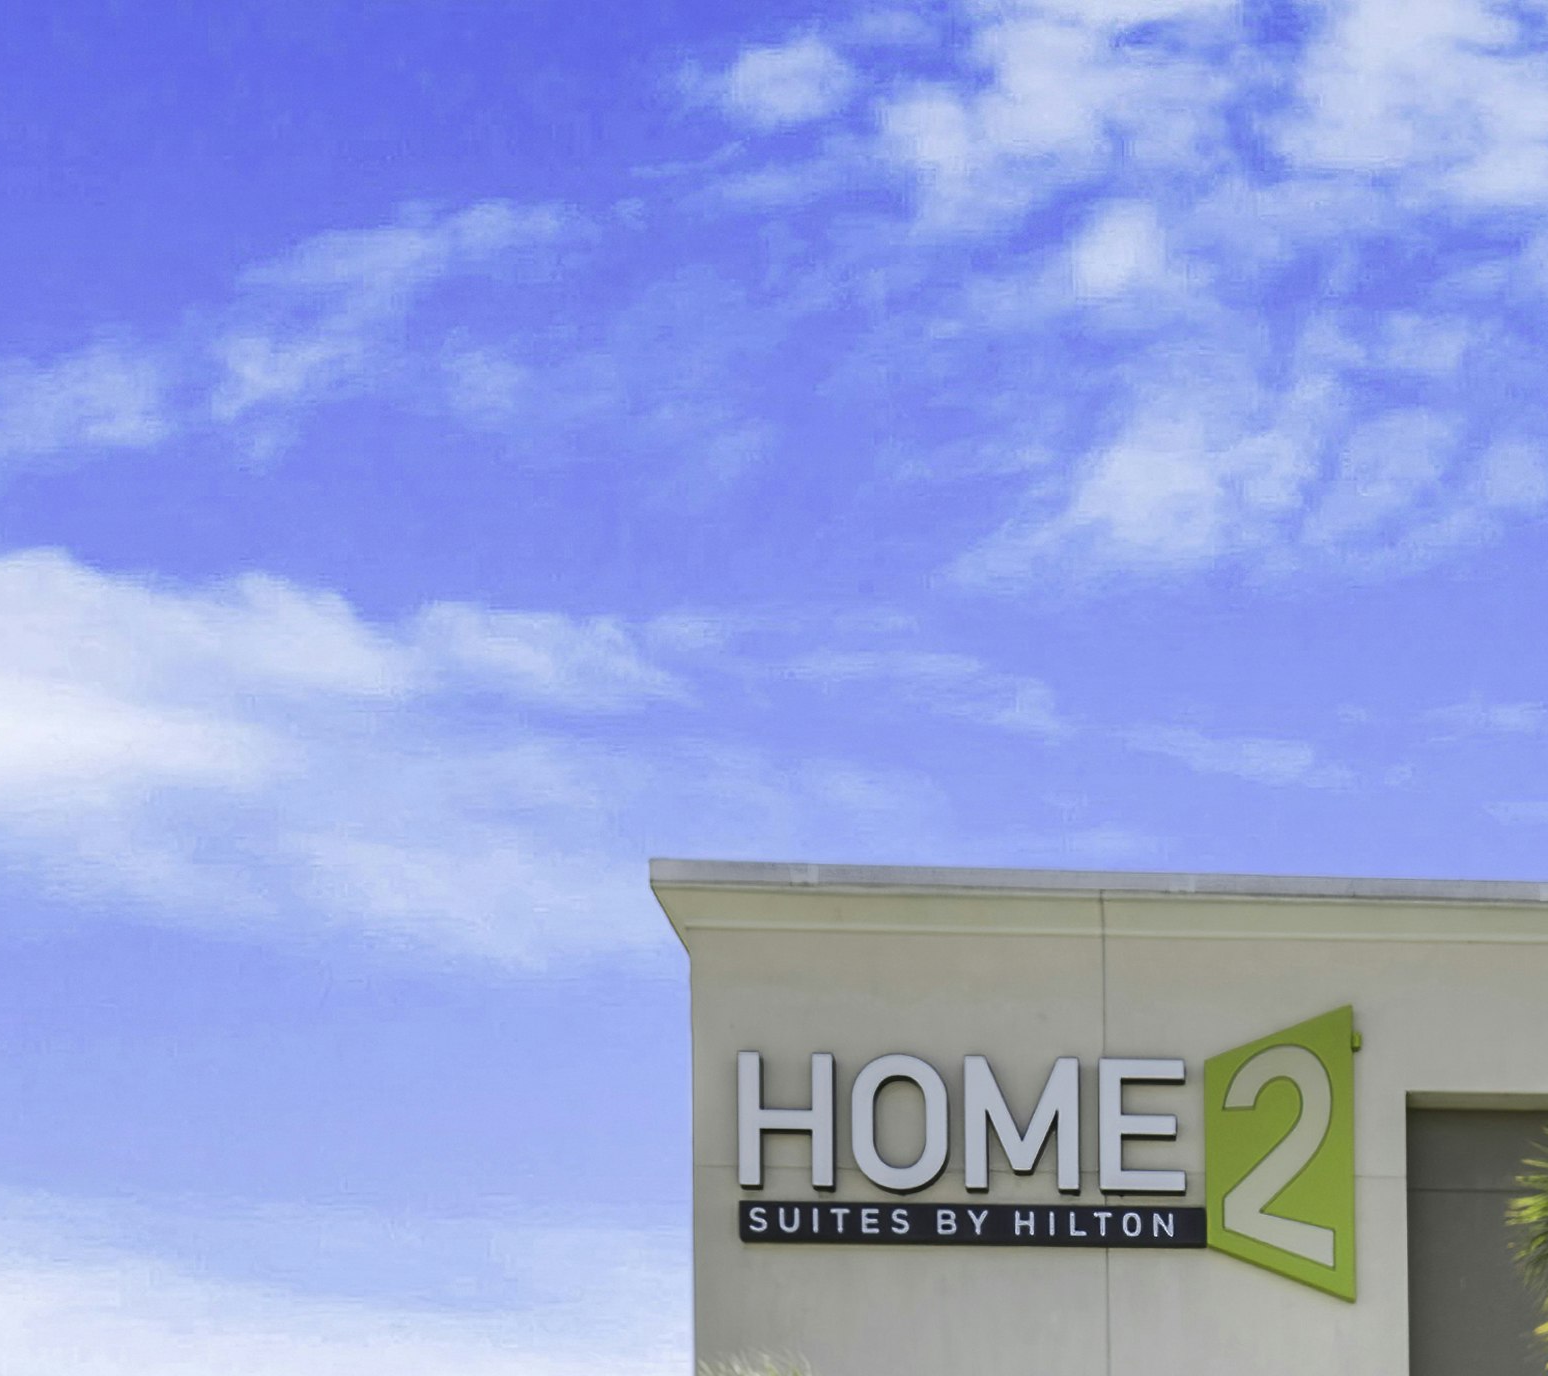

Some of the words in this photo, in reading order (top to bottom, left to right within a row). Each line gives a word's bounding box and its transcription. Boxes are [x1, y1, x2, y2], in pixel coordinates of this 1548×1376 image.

[736, 1050, 1187, 1195] HOME
[1221, 1043, 1336, 1271] 2
[748, 1206, 911, 1235] SUITES
[936, 1208, 989, 1237] BY
[1014, 1210, 1175, 1239] HILTON
